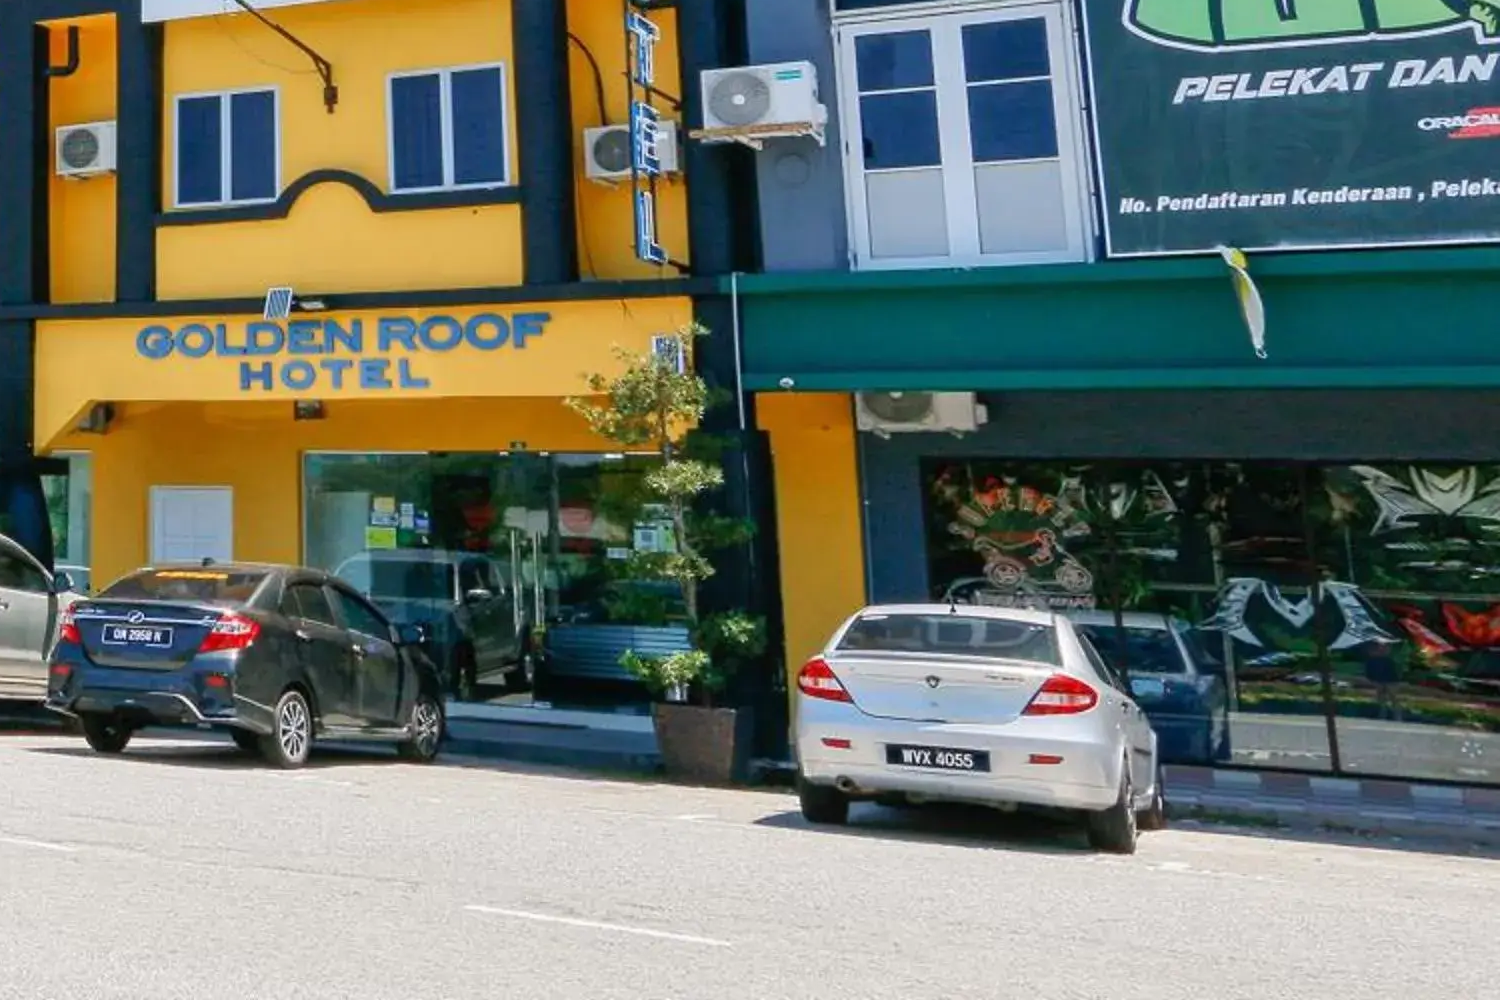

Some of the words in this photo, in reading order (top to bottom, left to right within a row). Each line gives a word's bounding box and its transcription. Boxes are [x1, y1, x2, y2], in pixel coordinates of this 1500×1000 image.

[1172, 62, 1384, 104] PELEKAT
[1388, 53, 1500, 88] DAN
[1120, 197, 1151, 214] No.
[1157, 190, 1286, 213] Pendaftaran
[1291, 186, 1411, 206] Kenderaan
[1431, 178, 1500, 198] Pelek
[136, 318, 363, 358] GOLDEN
[378, 312, 551, 353] ROOF
[239, 358, 431, 391] HOTEL
[902, 748, 932, 765] WVX
[935, 751, 973, 769] 4055
